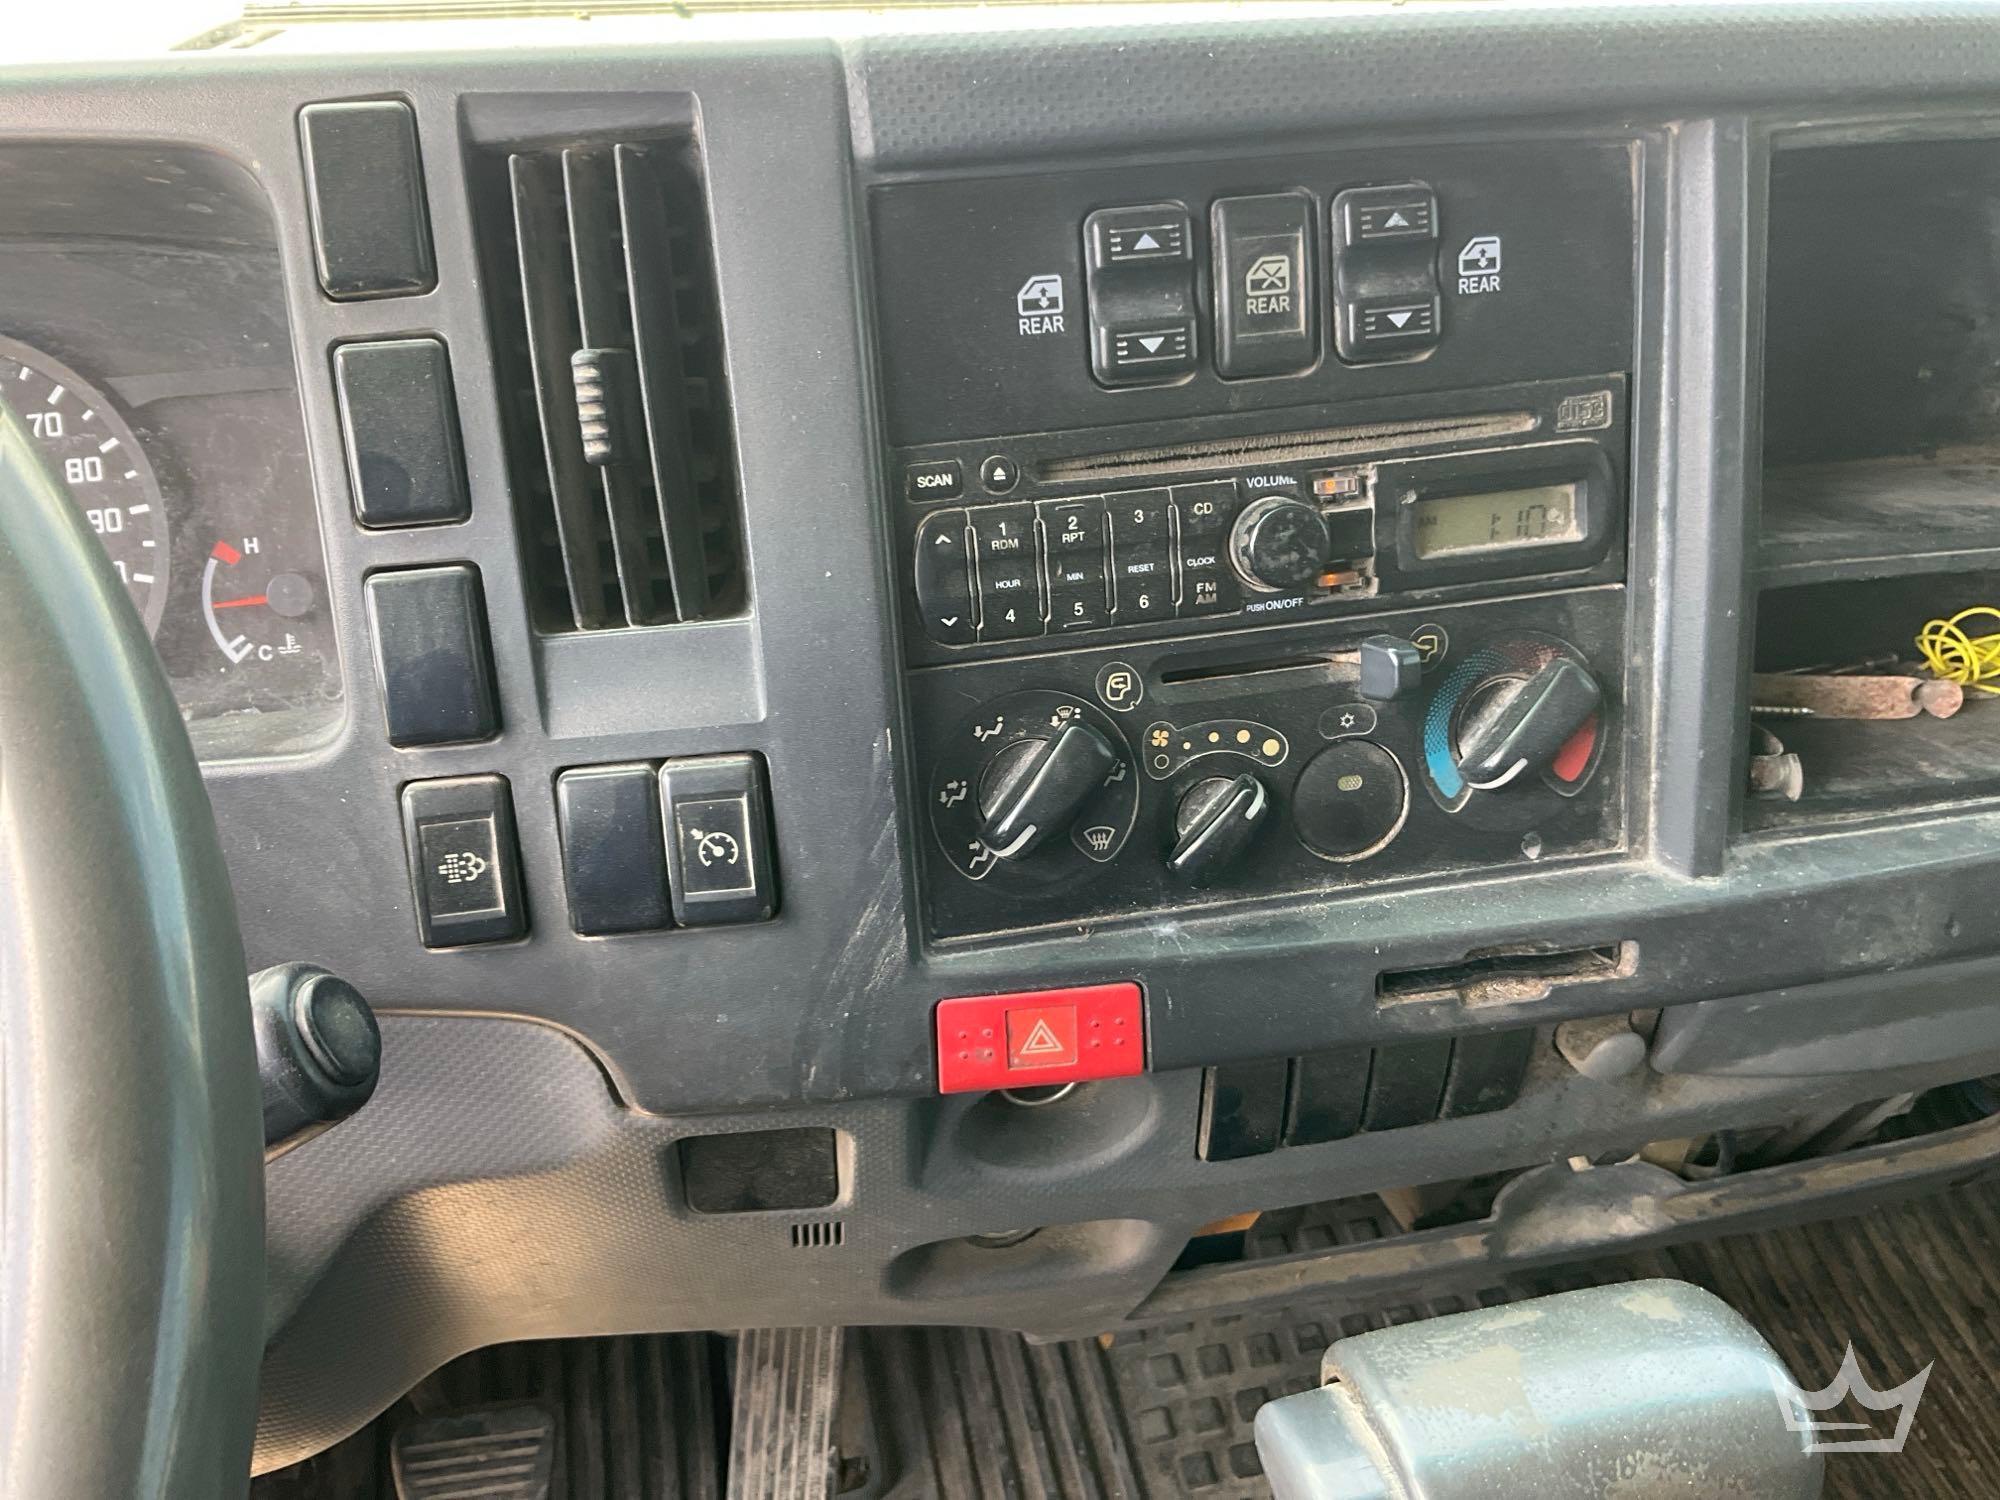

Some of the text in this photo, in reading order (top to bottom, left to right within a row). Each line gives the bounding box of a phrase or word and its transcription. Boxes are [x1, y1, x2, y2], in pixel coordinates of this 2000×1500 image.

[1459, 276, 1501, 294] REAR
[1246, 296, 1291, 314] REAR
[1018, 315, 1065, 335] REAR
[26, 412, 62, 438] 70
[65, 457, 102, 483] 80
[916, 474, 953, 488] SCAN
[1134, 509, 1145, 524] 3
[1193, 502, 1214, 516] CD
[86, 508, 122, 533] 90
[1067, 516, 1079, 531] 2
[998, 522, 1007, 537] 1
[991, 538, 1019, 551] RDM
[1062, 531, 1086, 544] RPT
[243, 537, 260, 554] H
[1127, 563, 1155, 574] RESET
[1186, 556, 1216, 567] CLOCK
[995, 578, 1021, 589] HOUR
[1066, 572, 1084, 581] MIN
[1196, 582, 1217, 593] FM
[1139, 594, 1150, 609] 6
[1195, 593, 1217, 605] AM
[1246, 597, 1304, 612] PUSH ON/OFF
[1005, 608, 1016, 623] 4
[1073, 601, 1085, 617] 5
[258, 645, 273, 661] C
